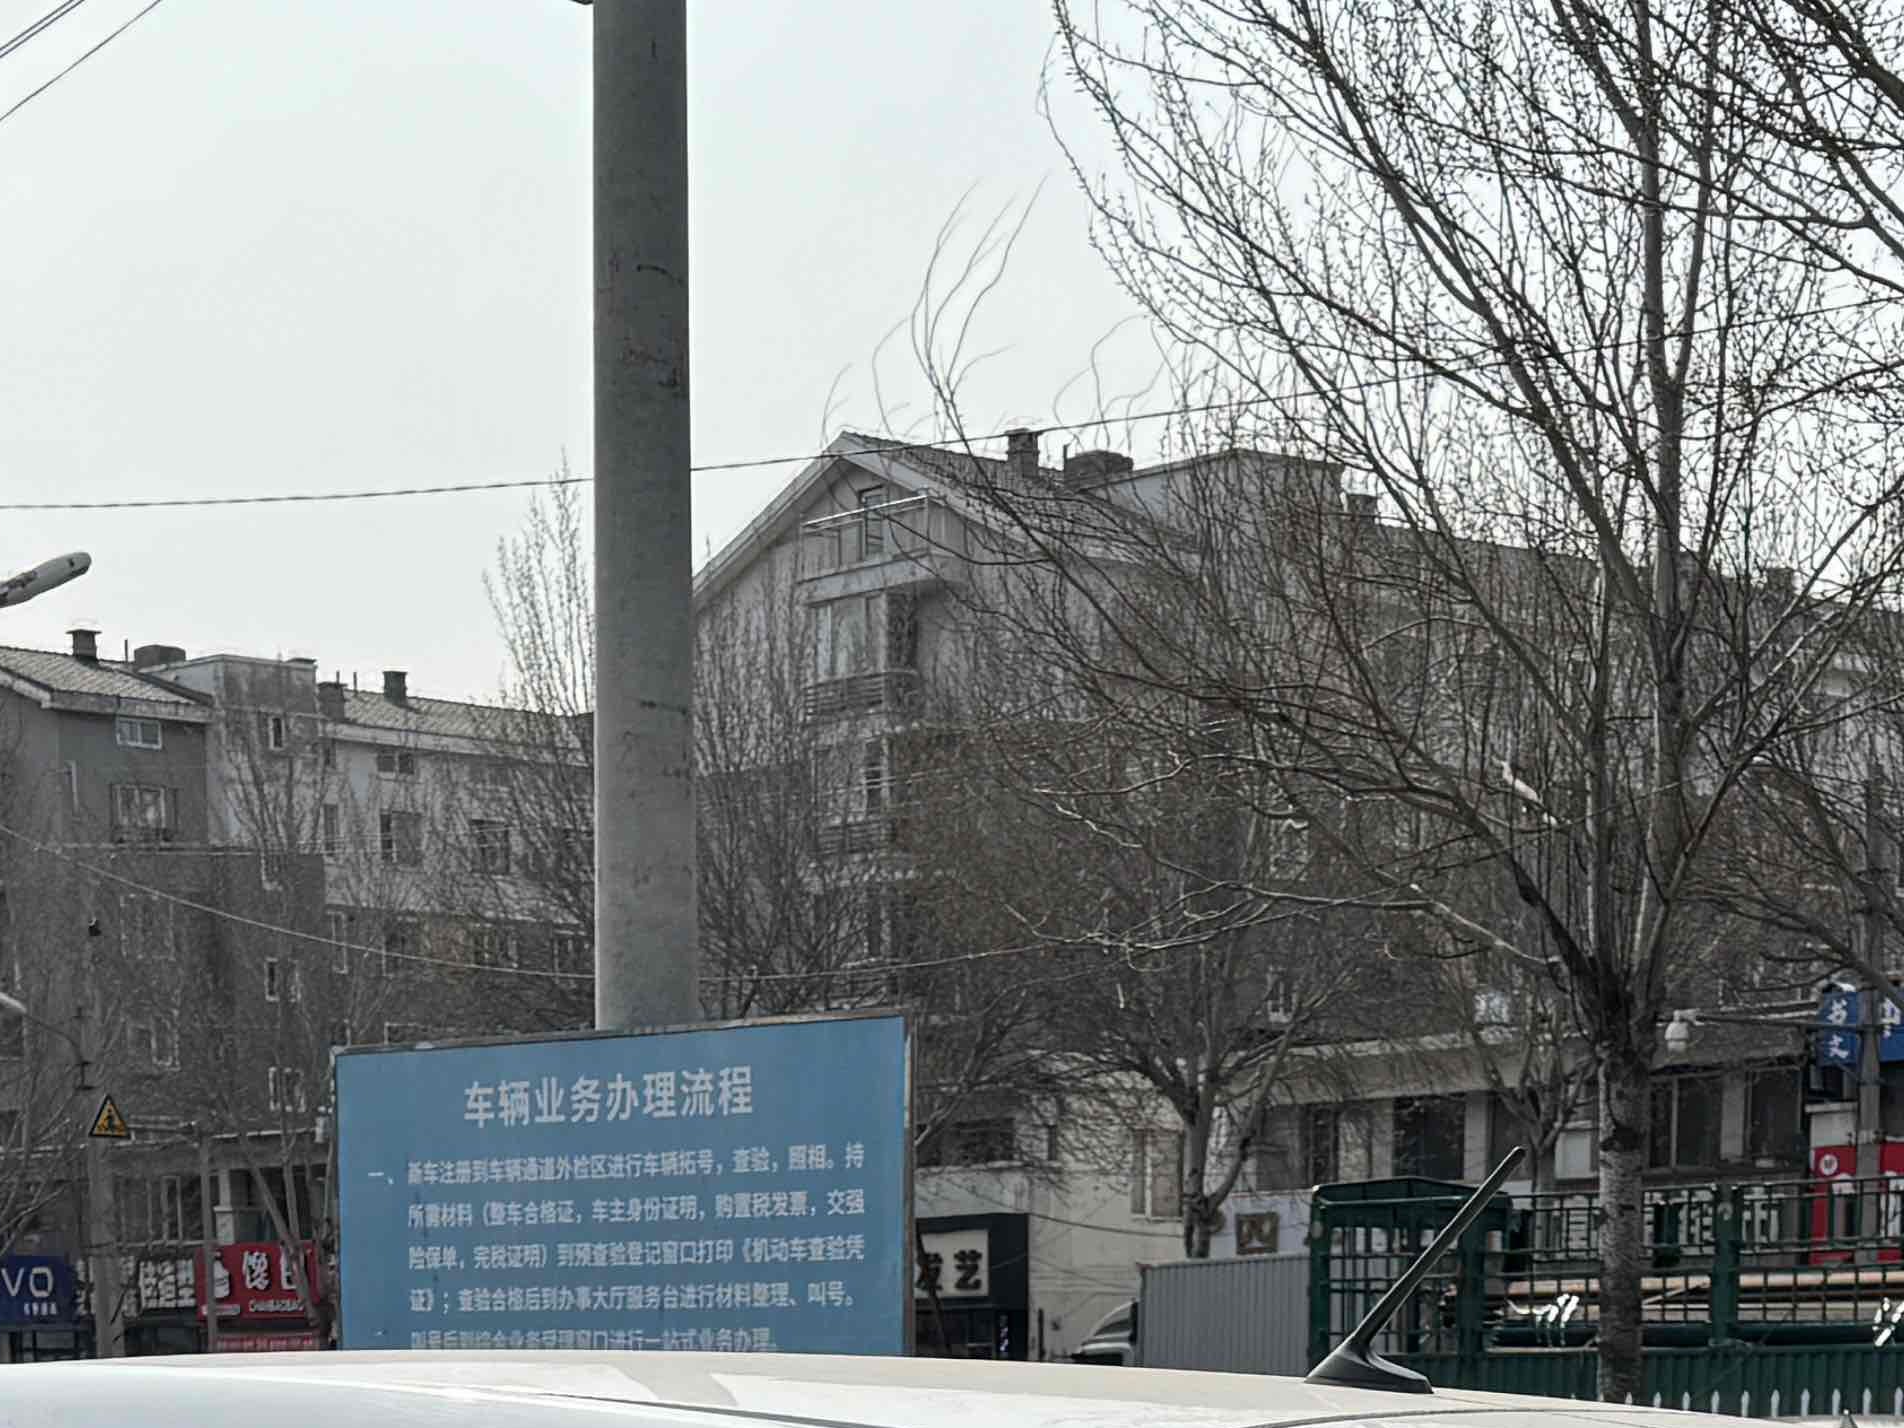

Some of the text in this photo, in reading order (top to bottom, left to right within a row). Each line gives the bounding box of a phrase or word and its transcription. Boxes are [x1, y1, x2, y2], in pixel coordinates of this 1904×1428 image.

[463, 1064, 753, 1129] 车辆业务办理流程
